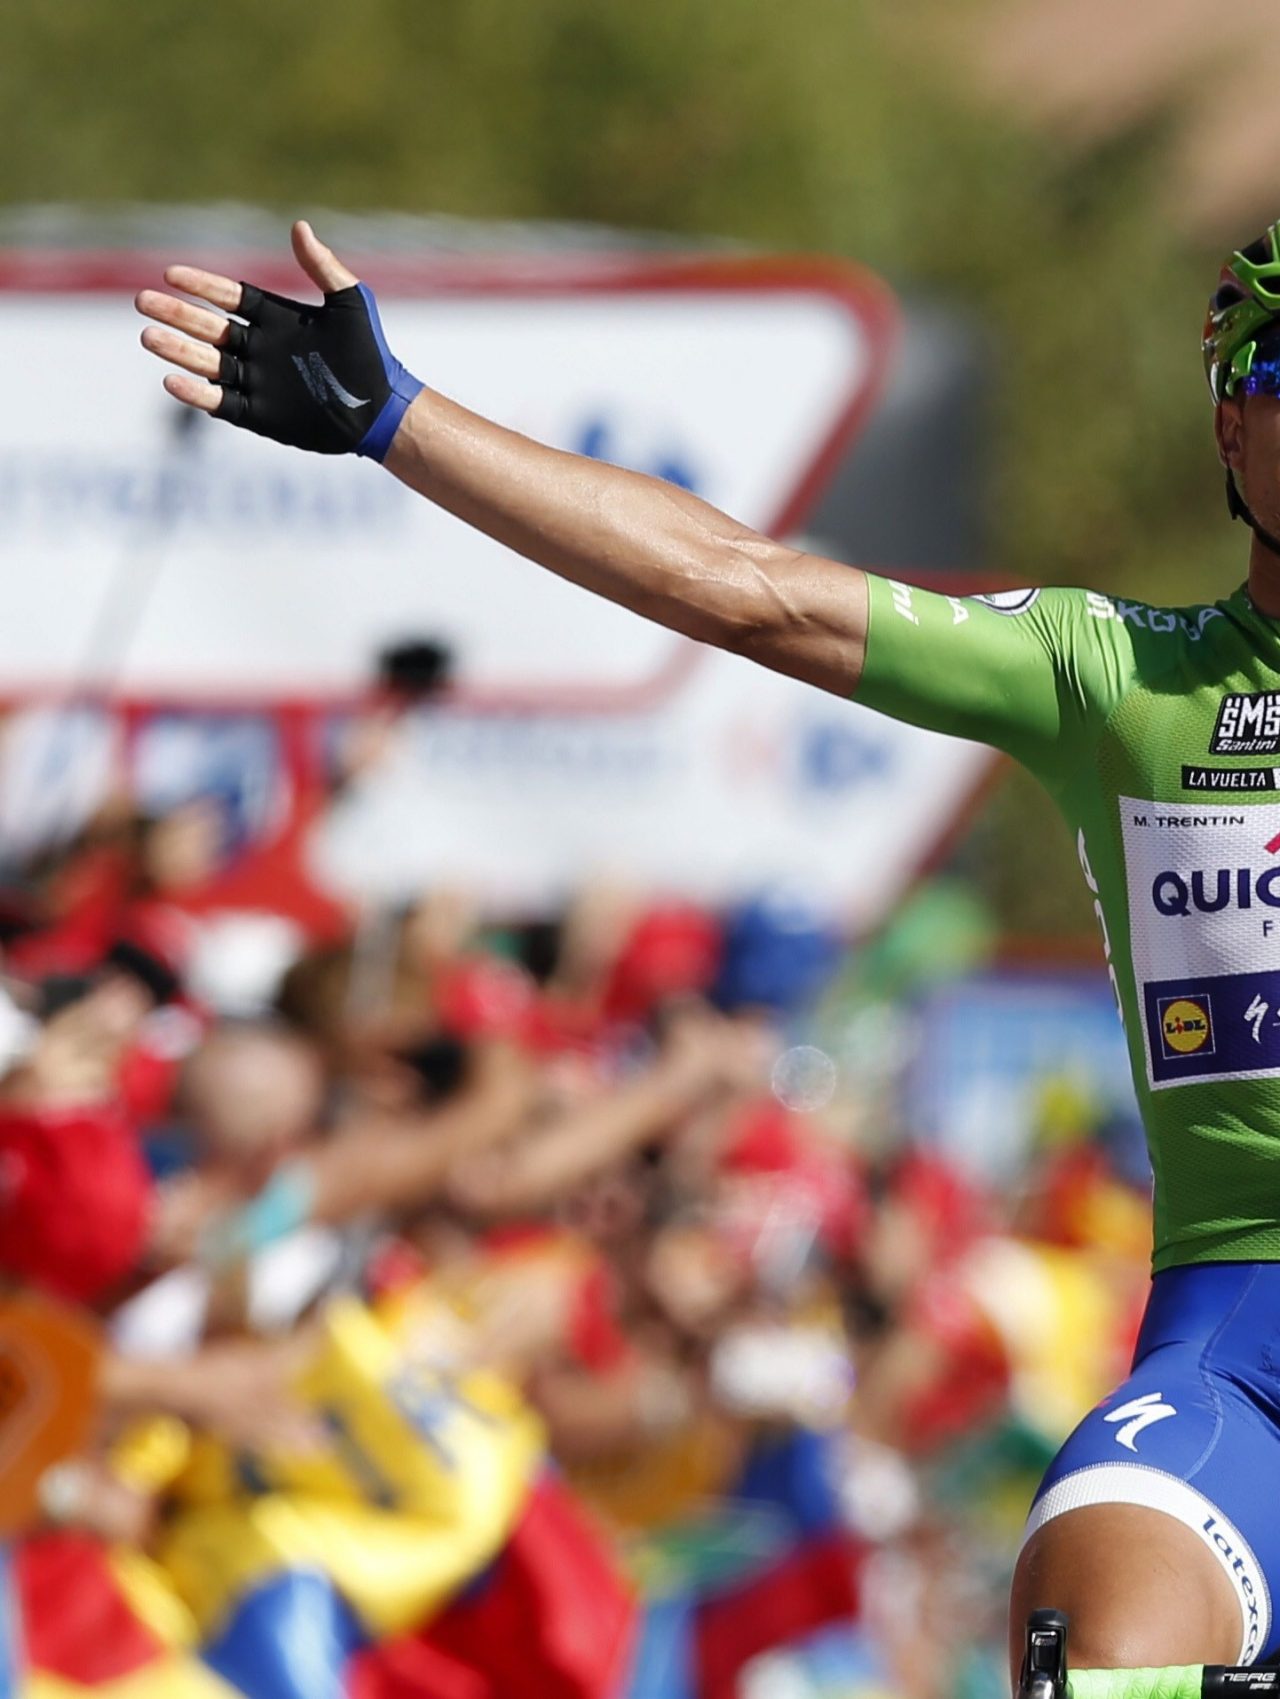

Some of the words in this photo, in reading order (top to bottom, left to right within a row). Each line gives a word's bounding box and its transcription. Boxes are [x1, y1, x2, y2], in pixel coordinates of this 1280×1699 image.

[1215, 737, 1279, 751] Santini
[1210, 771, 1266, 788] VUELTA
[1133, 815, 1151, 828] M.
[1155, 814, 1244, 828] TRENTIN
